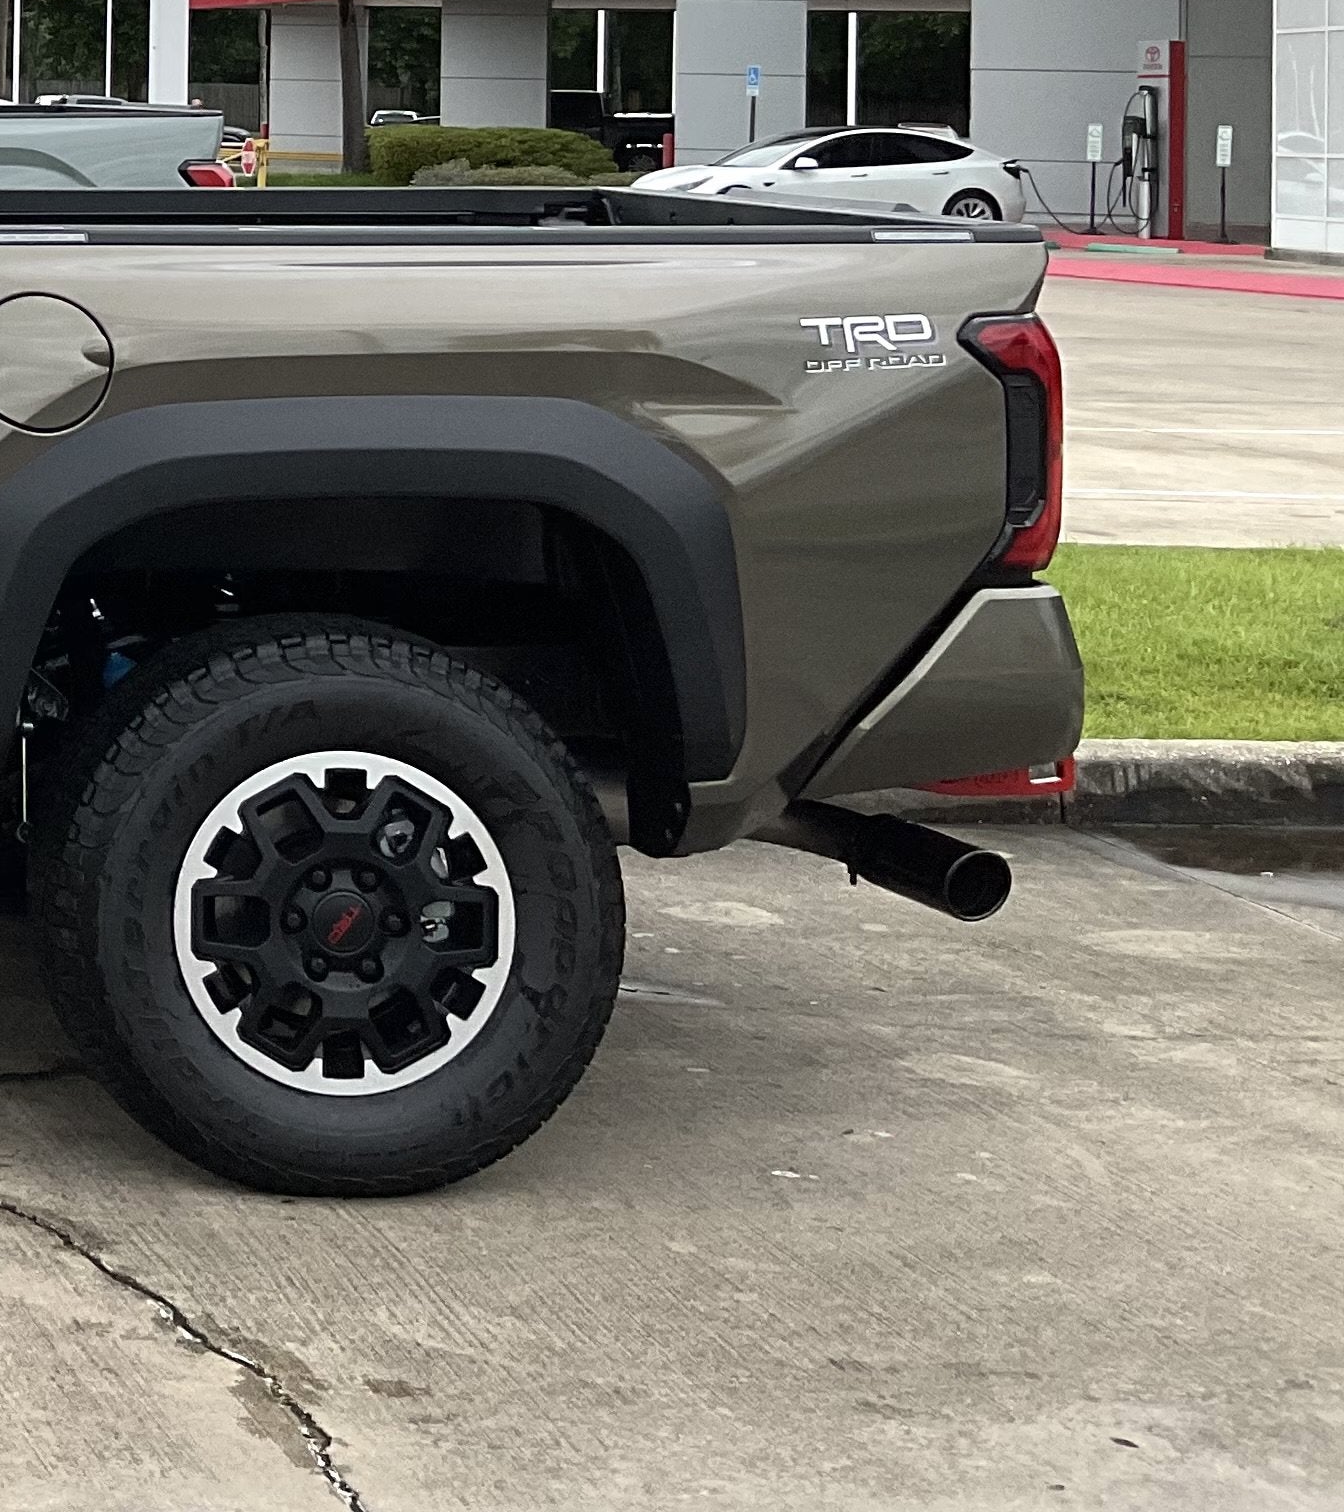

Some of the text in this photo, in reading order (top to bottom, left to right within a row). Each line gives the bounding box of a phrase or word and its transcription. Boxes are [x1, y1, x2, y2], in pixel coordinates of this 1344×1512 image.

[799, 313, 933, 353] TRD
[805, 354, 947, 373] OFF ROAD
